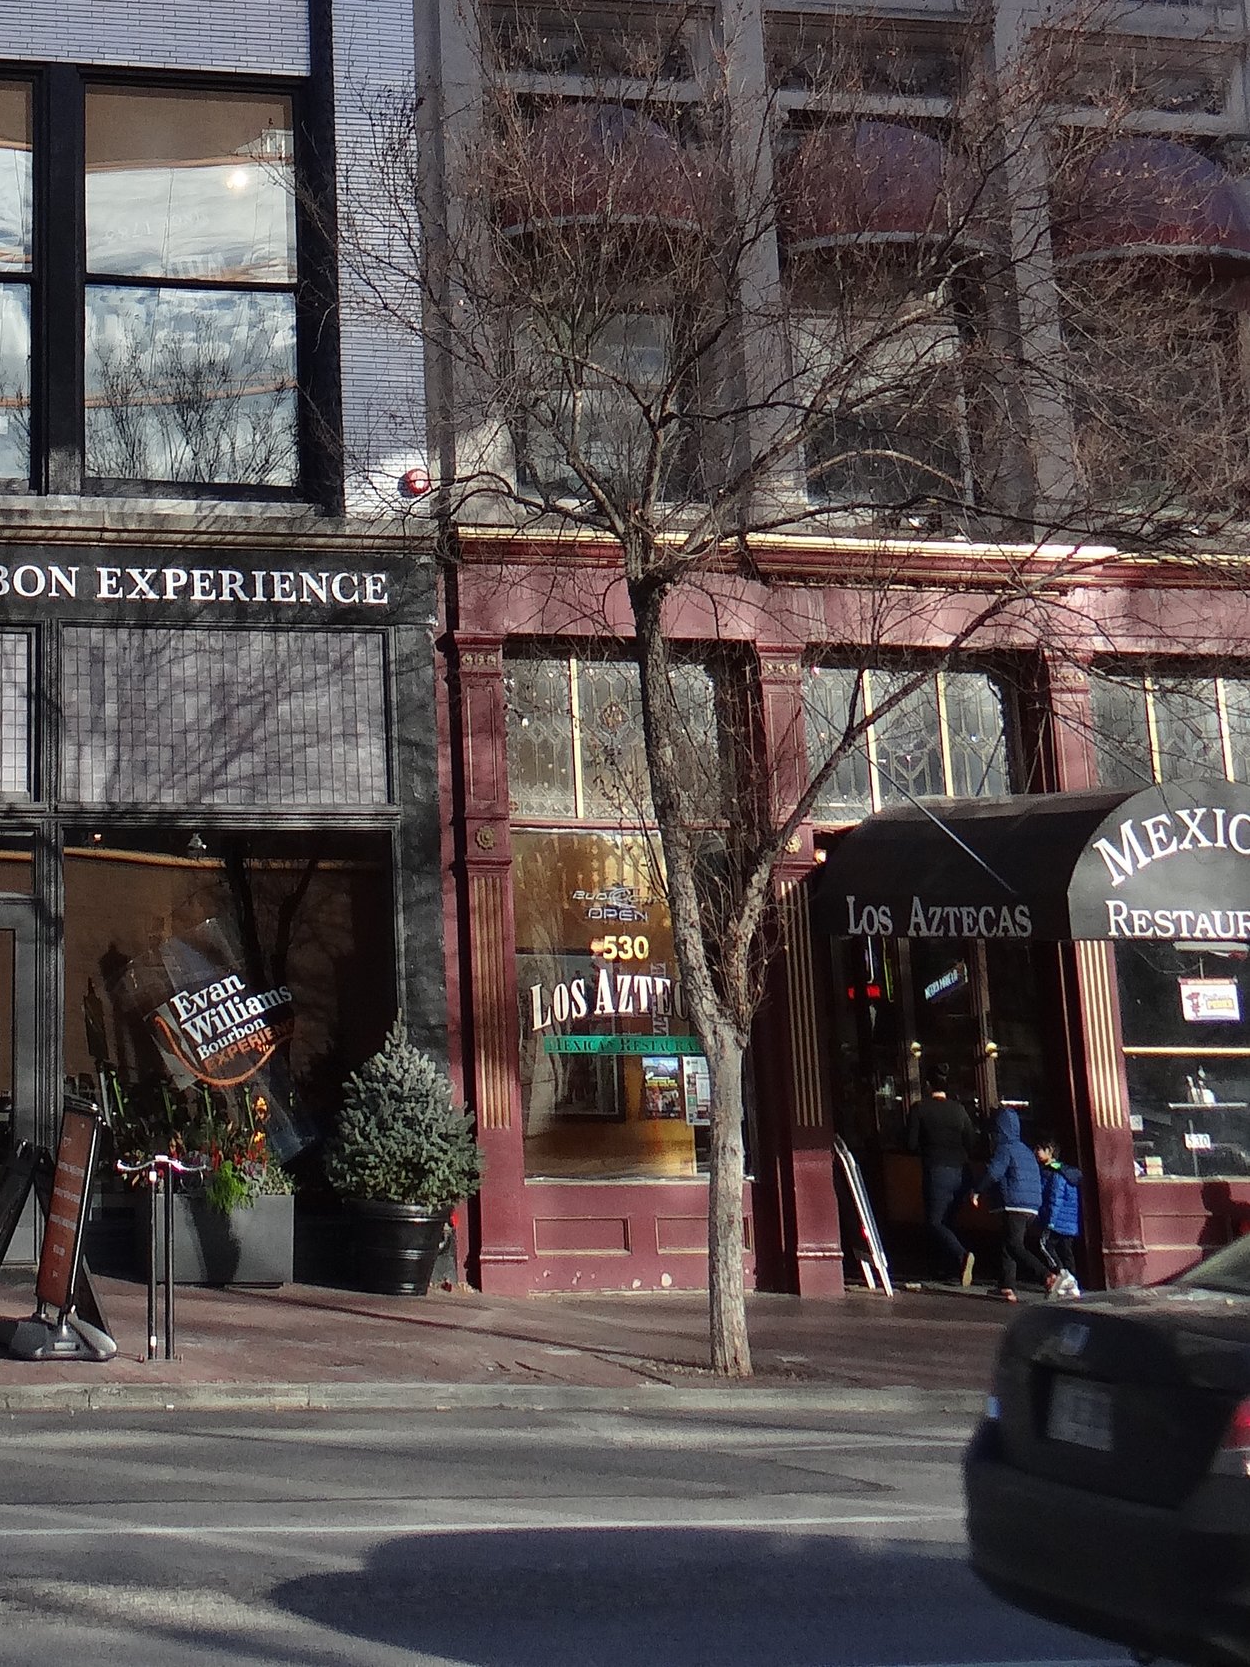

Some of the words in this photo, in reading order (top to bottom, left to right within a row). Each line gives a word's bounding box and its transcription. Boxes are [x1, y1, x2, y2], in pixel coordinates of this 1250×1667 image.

[95, 566, 388, 605] EXPERIENCE
[1092, 808, 1250, 887] MEXIC
[588, 907, 648, 922] OPEN
[603, 935, 649, 960] 530
[170, 973, 246, 1022] Evan
[181, 985, 293, 1045] Williams
[530, 978, 587, 1031] LOS
[594, 969, 691, 1021] AZTEC
[196, 1018, 266, 1061] Bourbon
[620, 1036, 698, 1052] RESTAURA
[1188, 1135, 1208, 1147] 530
